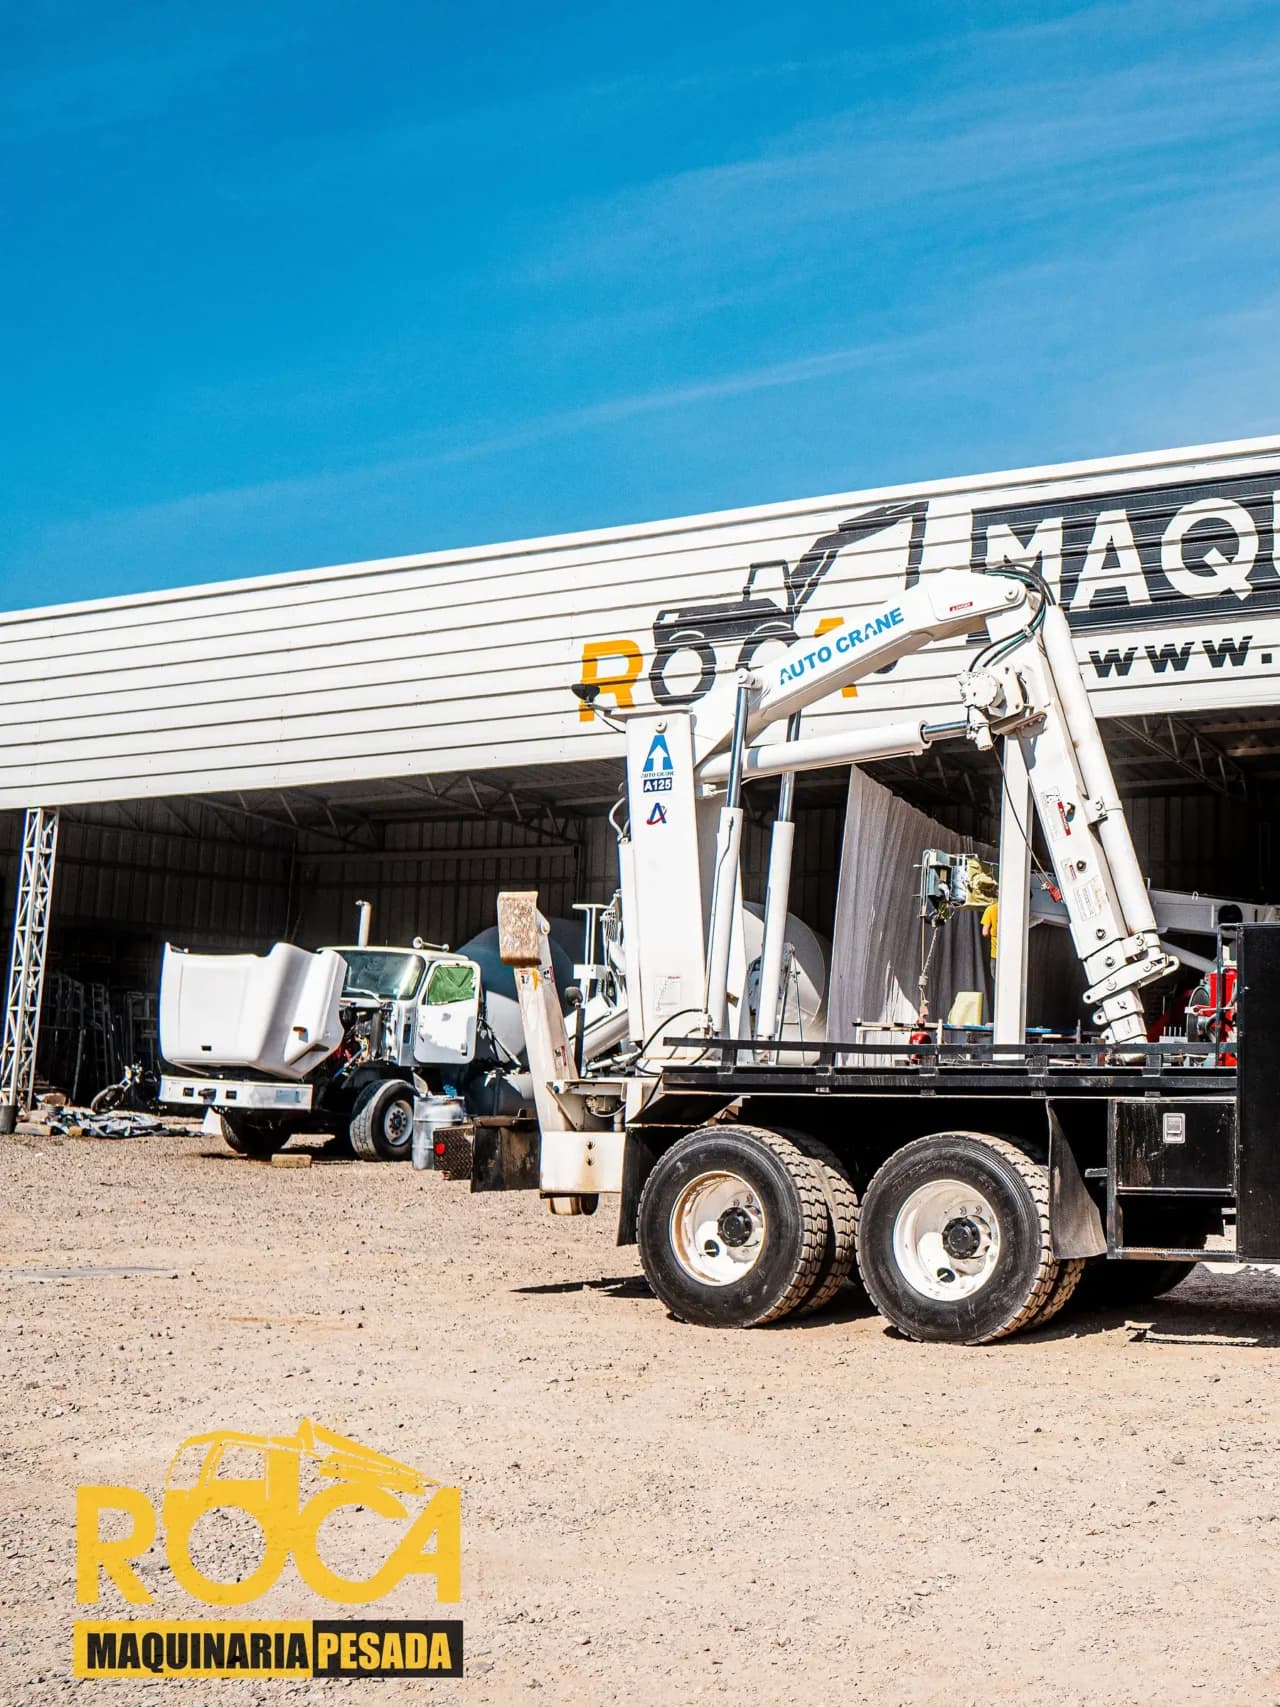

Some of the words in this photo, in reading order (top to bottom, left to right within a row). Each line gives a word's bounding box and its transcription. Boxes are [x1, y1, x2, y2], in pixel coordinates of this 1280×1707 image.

[779, 646, 832, 685] AUTO
[835, 607, 905, 653] CRANE
[644, 780, 672, 791] A125
